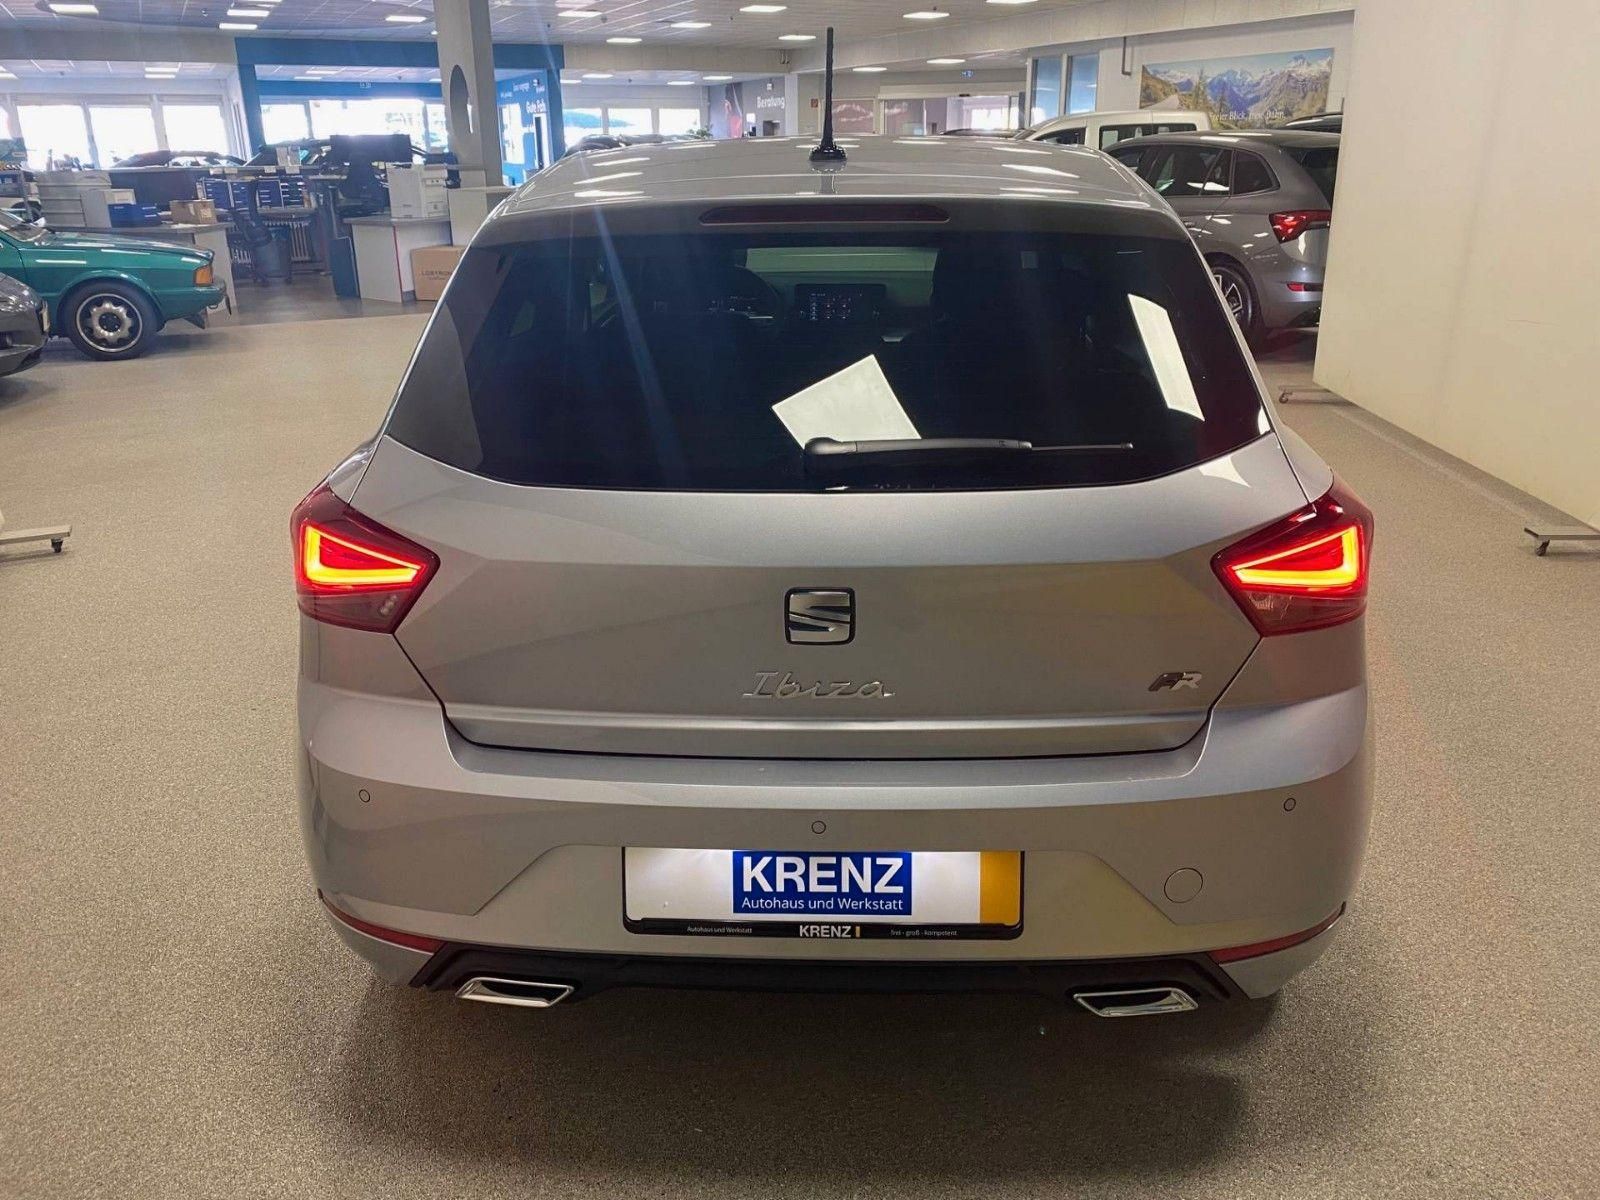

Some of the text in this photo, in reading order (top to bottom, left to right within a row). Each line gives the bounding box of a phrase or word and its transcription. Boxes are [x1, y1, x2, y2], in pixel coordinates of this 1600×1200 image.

[756, 96, 785, 109] Beratung
[742, 670, 896, 701] Ibiza
[742, 856, 904, 893] KRENZ
[741, 897, 904, 911] Autohaus und Werkstatt
[686, 925, 714, 933] Autohaus
[725, 926, 753, 934] Werkstatt
[799, 924, 852, 938] KRENZ
